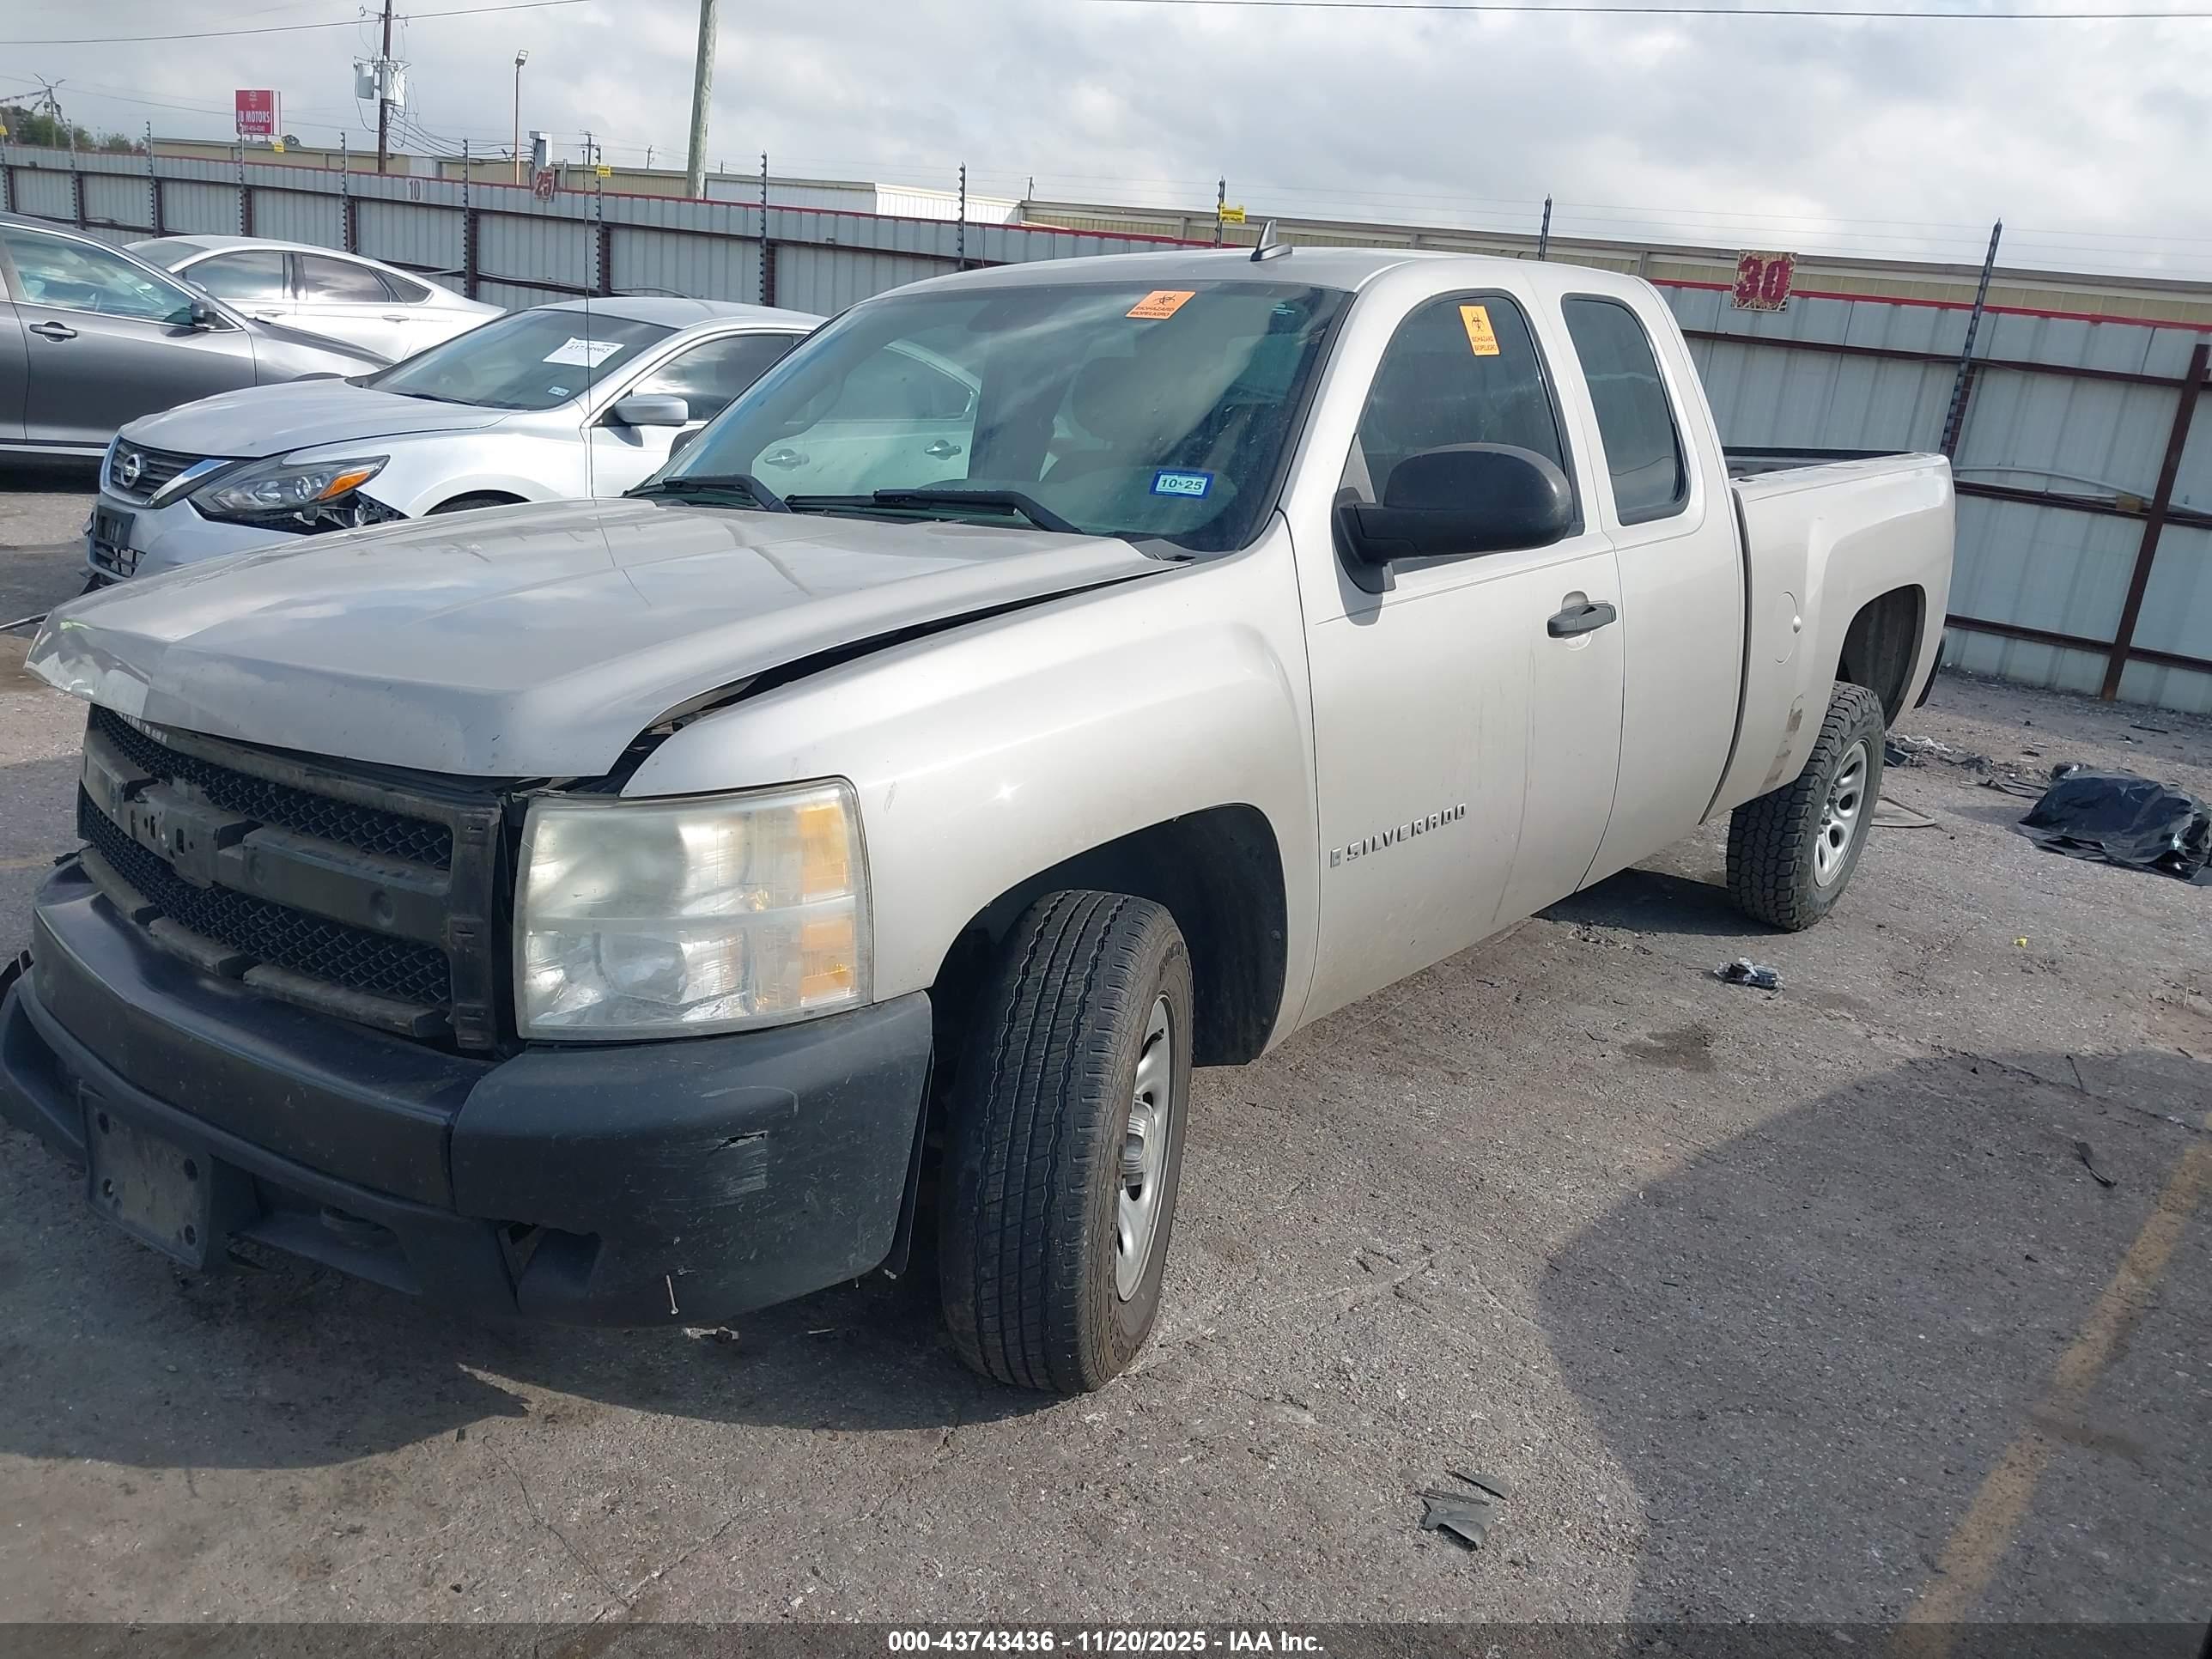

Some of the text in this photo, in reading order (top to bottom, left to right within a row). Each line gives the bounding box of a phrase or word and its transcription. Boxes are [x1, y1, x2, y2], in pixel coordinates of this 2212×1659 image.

[246, 110, 270, 124] MOTORS
[409, 179, 421, 201] 10
[535, 171, 554, 197] 25
[1736, 256, 1791, 303] 30
[1346, 803, 1467, 861] SILVERADO
